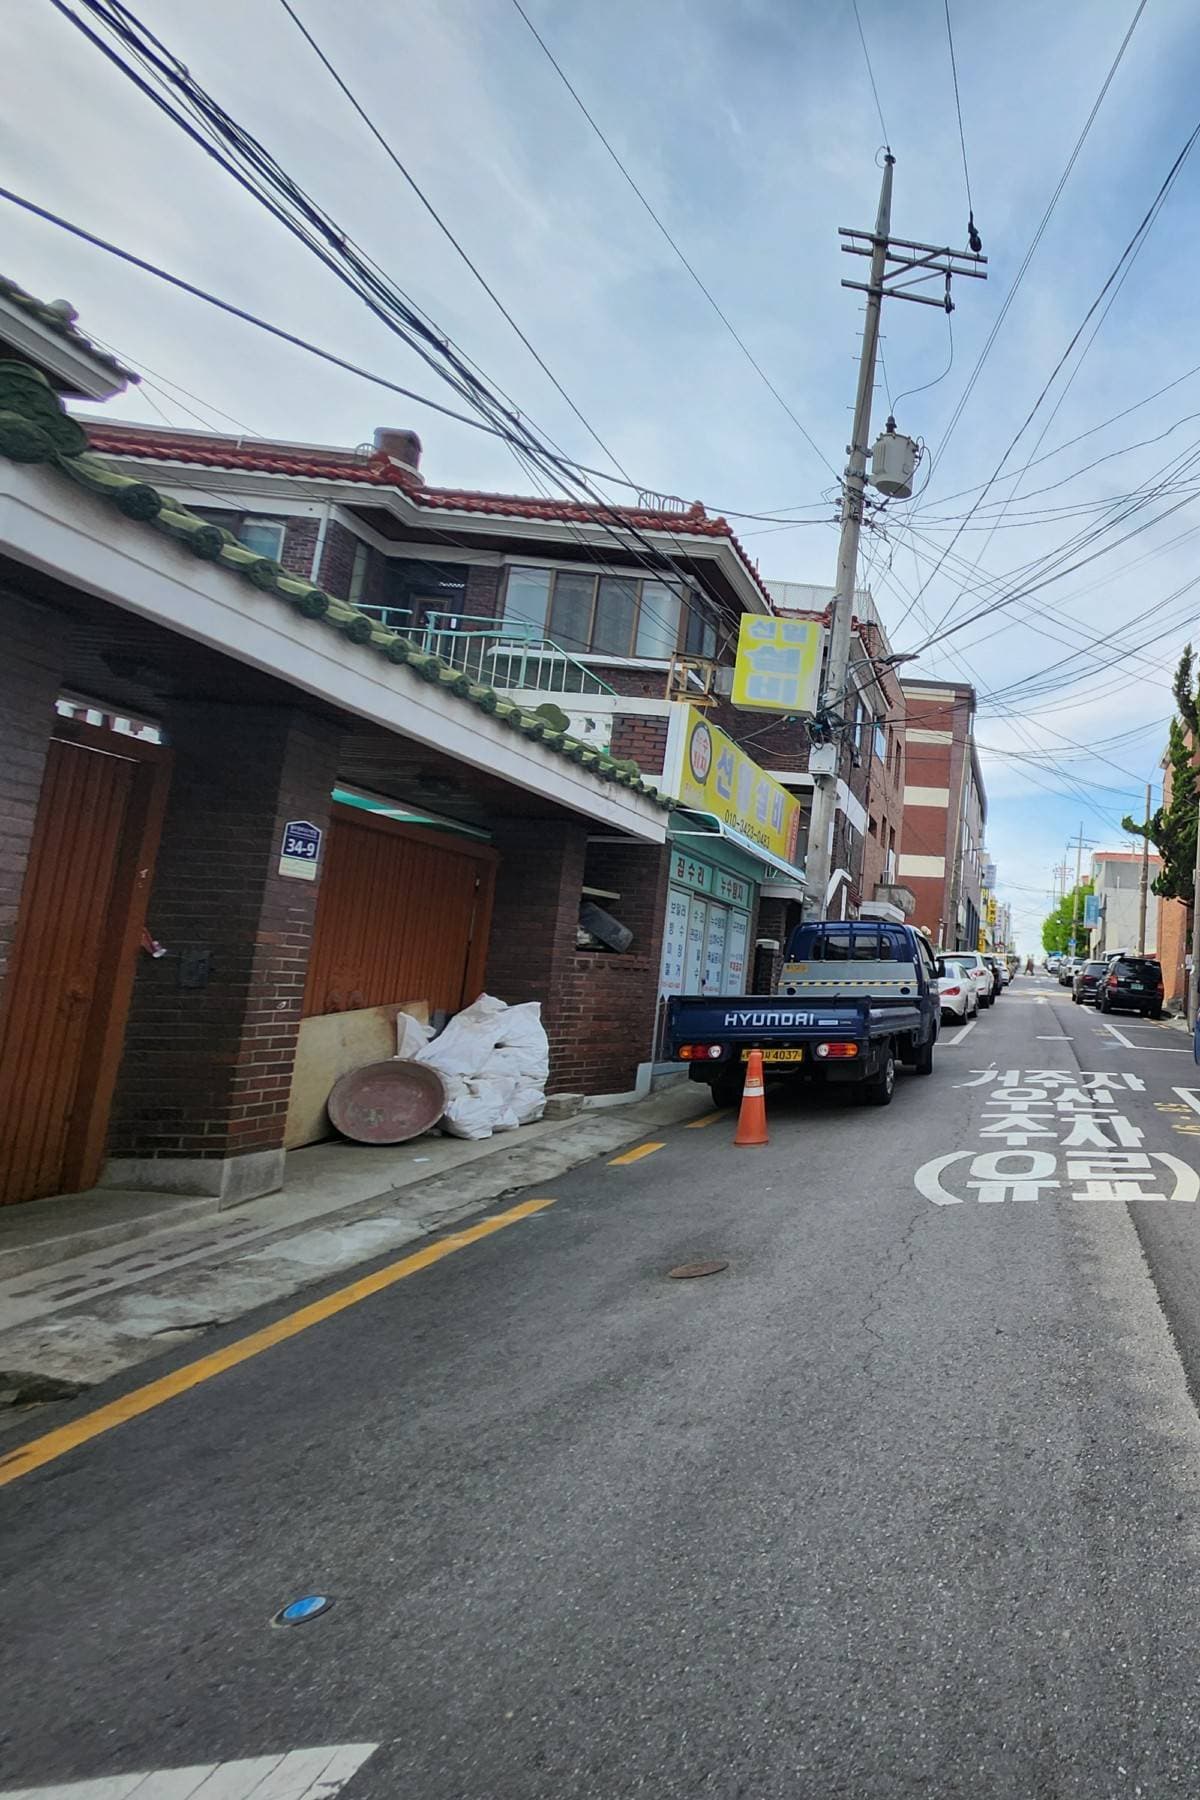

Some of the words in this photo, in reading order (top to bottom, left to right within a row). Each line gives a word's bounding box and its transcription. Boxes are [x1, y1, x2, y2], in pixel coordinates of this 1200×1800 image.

[286, 838, 315, 857] 34-9
[676, 857, 705, 887] 집수리
[724, 1012, 814, 1027] HYUNDAI
[956, 1069, 1147, 1091] 거주자
[985, 1087, 1119, 1114] 우선
[979, 1113, 1146, 1148] 주차
[914, 1150, 1200, 1207] (유료)
